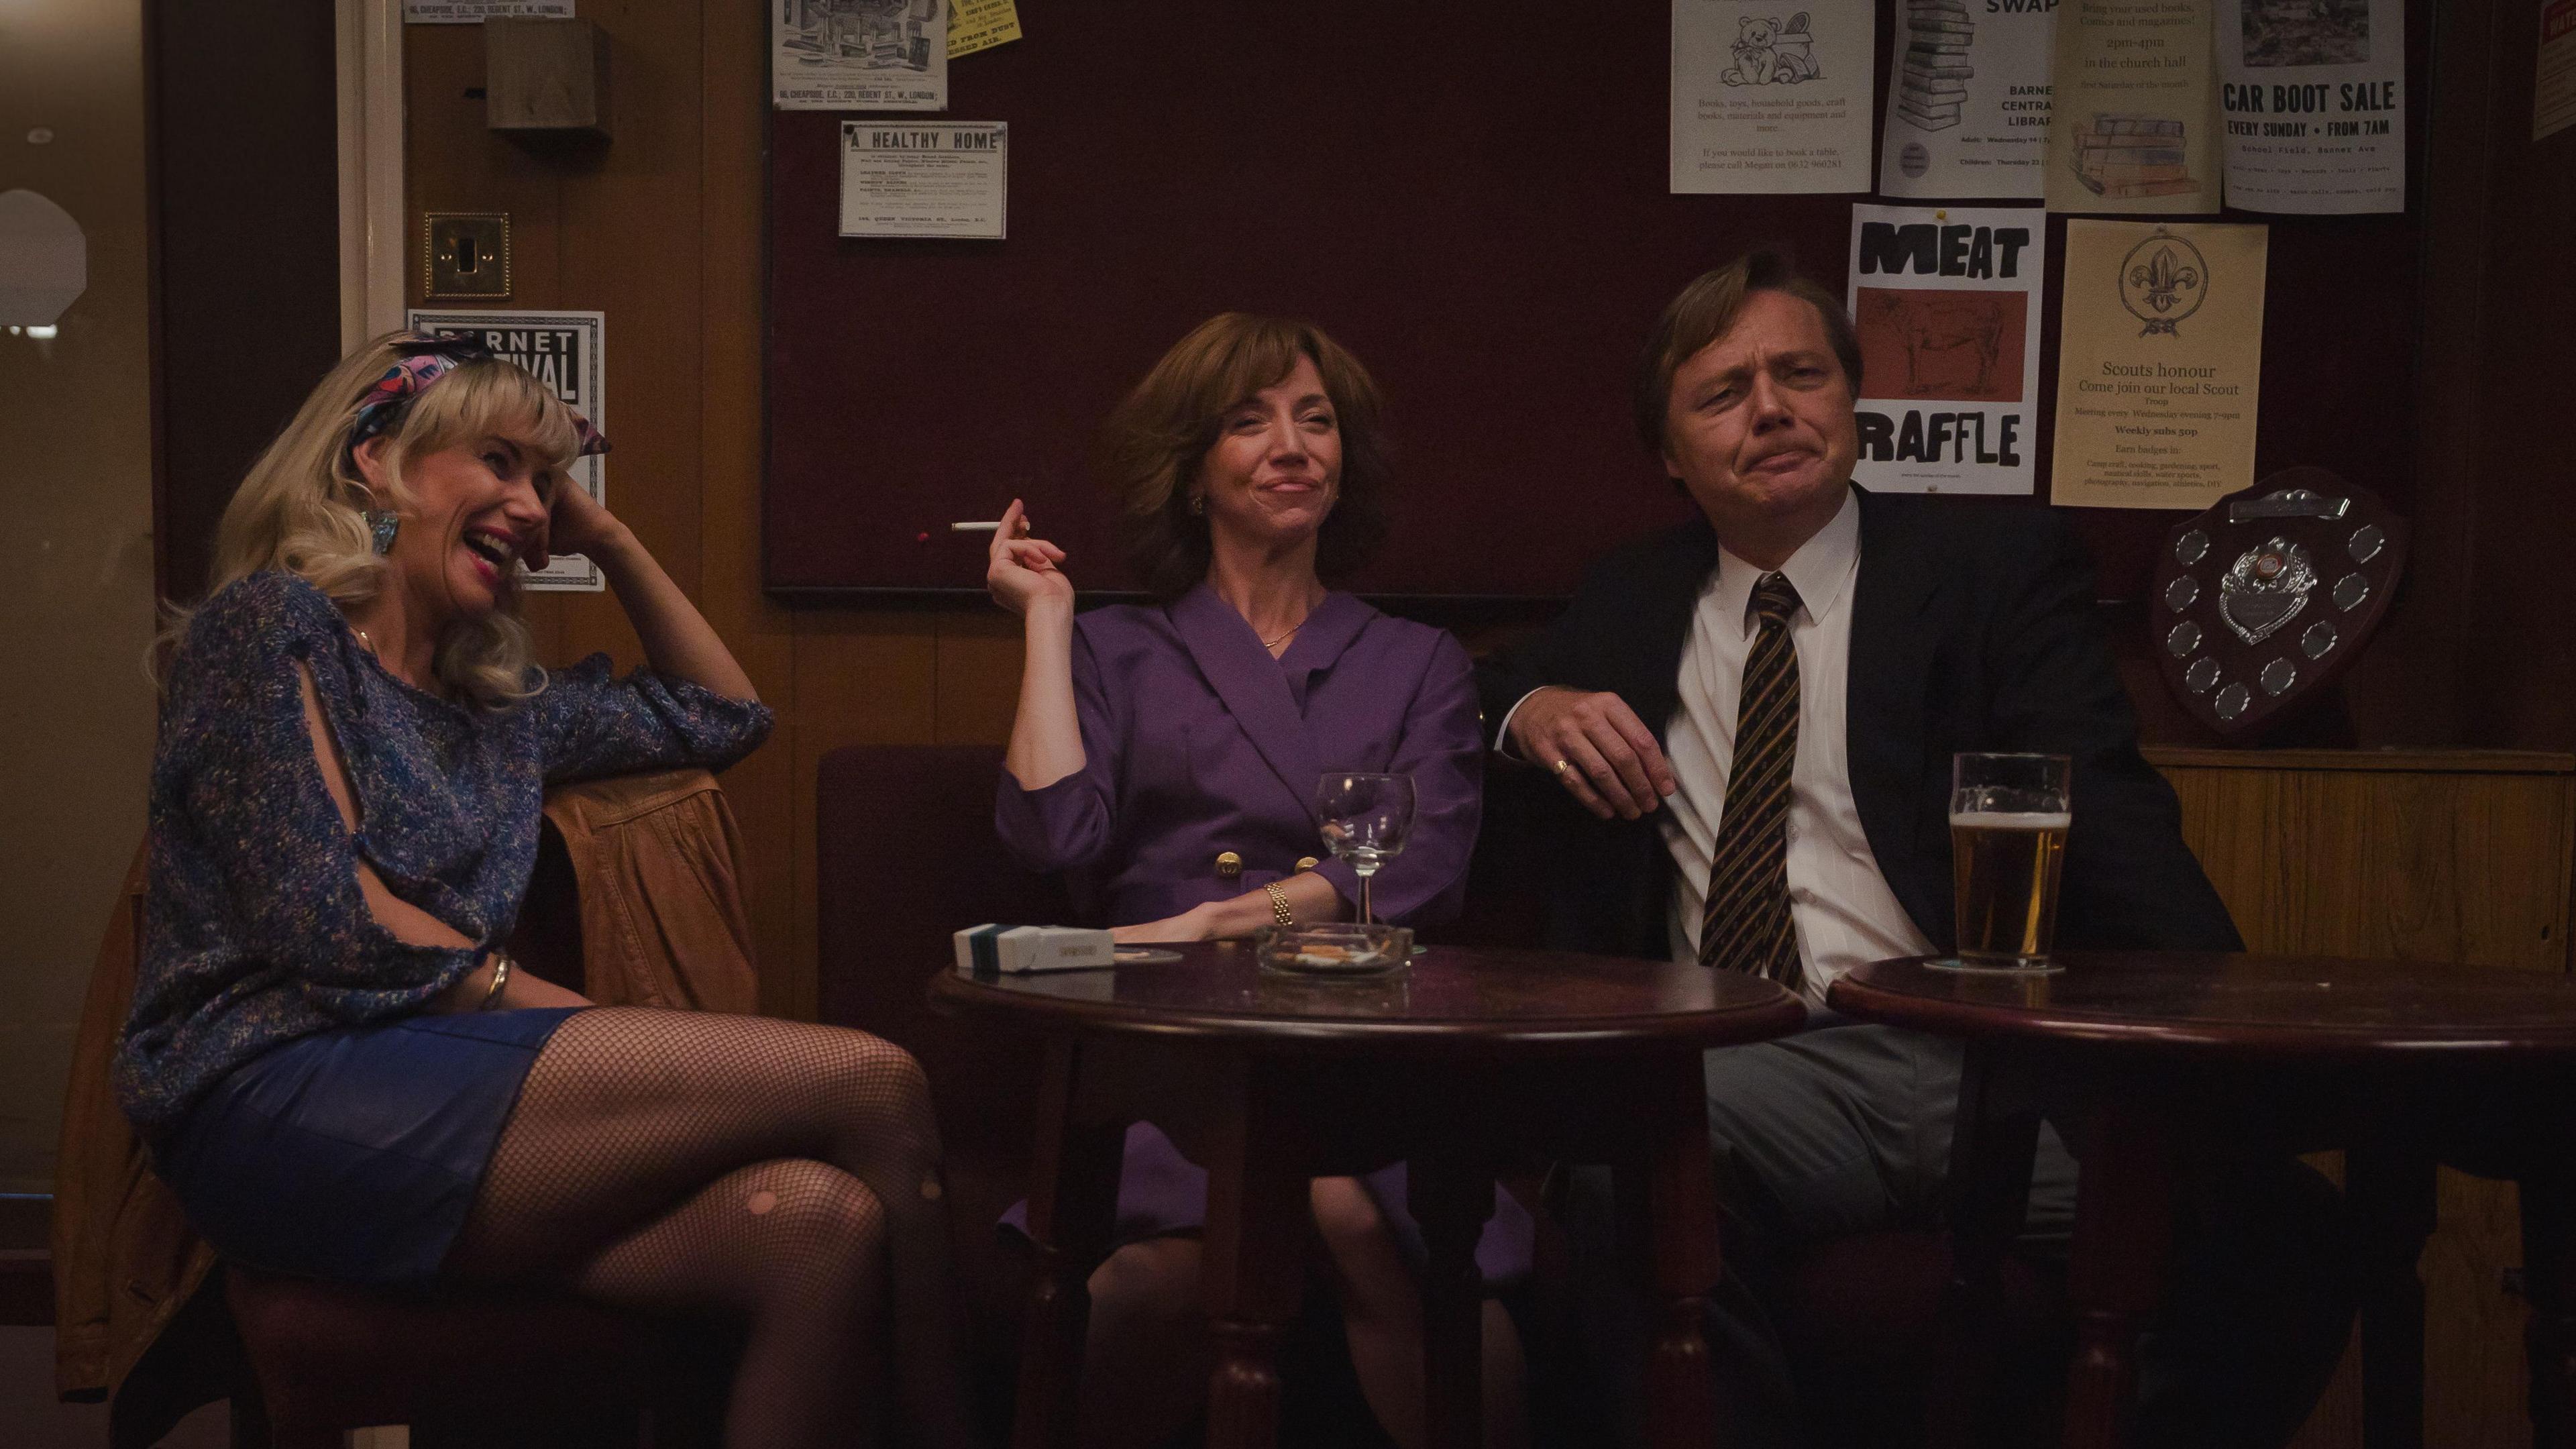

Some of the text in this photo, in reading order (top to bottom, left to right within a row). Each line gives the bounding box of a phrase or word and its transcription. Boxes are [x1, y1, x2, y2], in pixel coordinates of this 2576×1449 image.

[2083, 3, 2107, 15] Bring
[2135, 3, 2158, 13] used
[2080, 15, 2195, 28] Comics and magazines!
[961, 31, 987, 43] FROM
[991, 22, 1015, 34] DUST
[947, 37, 1002, 55] ESSED AIR.
[2107, 38, 2164, 50] 2pm-4pm
[2085, 56, 2186, 68] in the church hall
[2010, 86, 2053, 95] BARNE
[1752, 99, 1794, 107] household
[1826, 97, 1845, 107] craft
[2223, 81, 2396, 113] CAR BOOT SALE
[2001, 101, 2052, 111] CENTRA
[1727, 111, 1764, 120] materials
[1767, 111, 1782, 119] and
[1784, 111, 1828, 121] equipment
[1830, 110, 1845, 119] and
[2228, 119, 2389, 137] EVERY SUNDAY FROM 7AM
[851, 131, 997, 149] A HEALTHY HOME
[1703, 148, 1711, 157] If
[1712, 150, 1727, 159] you
[1730, 148, 1756, 157] would
[1758, 148, 1773, 156] like
[1786, 148, 1807, 156] book
[2242, 145, 2272, 154] School
[1699, 161, 1725, 171] please
[1727, 160, 1742, 169] call
[1745, 161, 1773, 170] Megan
[1996, 159, 2030, 167] Thursday
[1860, 222, 2030, 280] MEAT
[439, 329, 573, 352] RNET
[2102, 361, 2216, 378] Scouts honour
[2079, 380, 2239, 396] Come join our local Scout
[2146, 397, 2169, 407] Troop
[2075, 407, 2241, 421] Meeting every Wednesday evening 7-9pm
[2115, 425, 2198, 437] Weekly subs 50p
[1855, 410, 2021, 467] RAFFLE
[2115, 445, 2135, 453] Earn
[2138, 445, 2167, 456] badges
[2087, 460, 2107, 469] Camp
[2207, 480, 2222, 488] DIY
